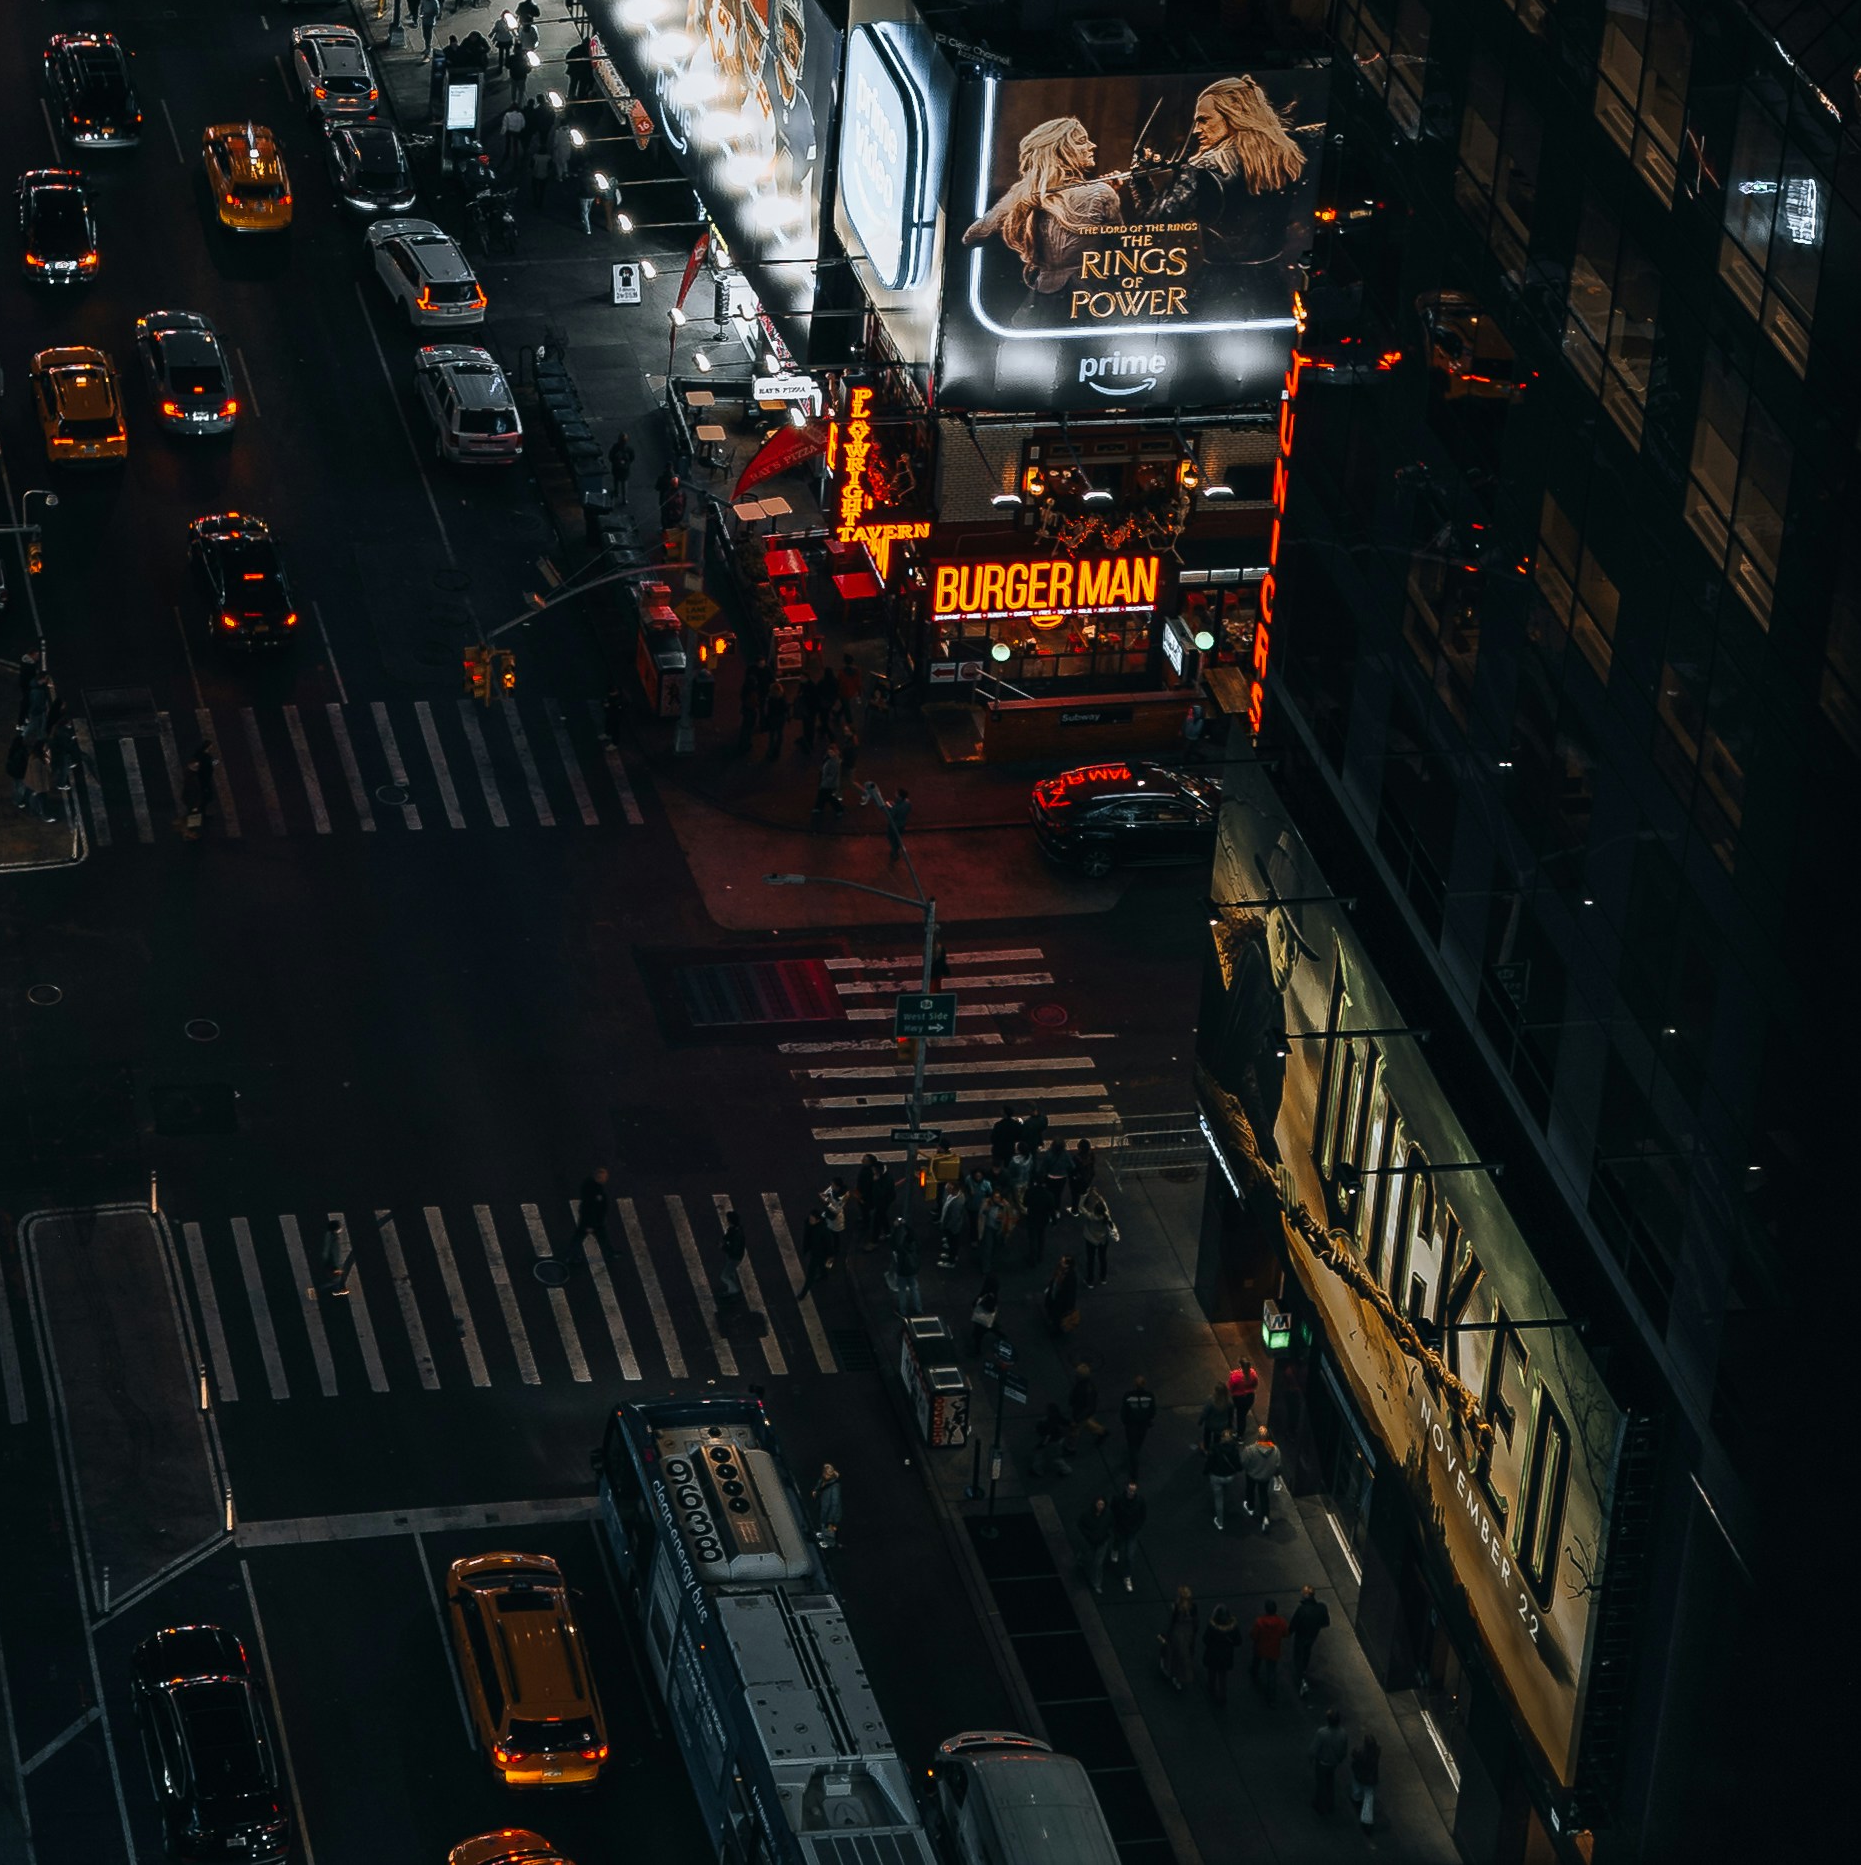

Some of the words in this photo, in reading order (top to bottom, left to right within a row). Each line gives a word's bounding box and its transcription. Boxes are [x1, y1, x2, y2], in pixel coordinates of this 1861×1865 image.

[1078, 226, 1098, 235] THE
[1100, 225, 1127, 234] LORD
[1129, 224, 1143, 233] OF
[1145, 223, 1165, 232] THE
[1167, 222, 1198, 232] RINGS
[1121, 235, 1153, 247] THE
[1080, 247, 1188, 280] RINGS
[1121, 276, 1144, 289] OF
[1070, 286, 1189, 319] POWER
[1079, 351, 1167, 382] prime
[783, 445, 818, 465] PIZZA
[836, 522, 931, 543] TAVERN
[934, 561, 1074, 613] BURGER
[1077, 556, 1159, 606] MAN
[1061, 712, 1101, 724] Subway
[932, 1397, 945, 1447] CHICAGO
[1421, 1397, 1511, 1587] NOVEMBER
[1519, 1592, 1539, 1644] 22
[652, 1479, 696, 1591] clean-energy
[689, 1586, 709, 1625] bus
